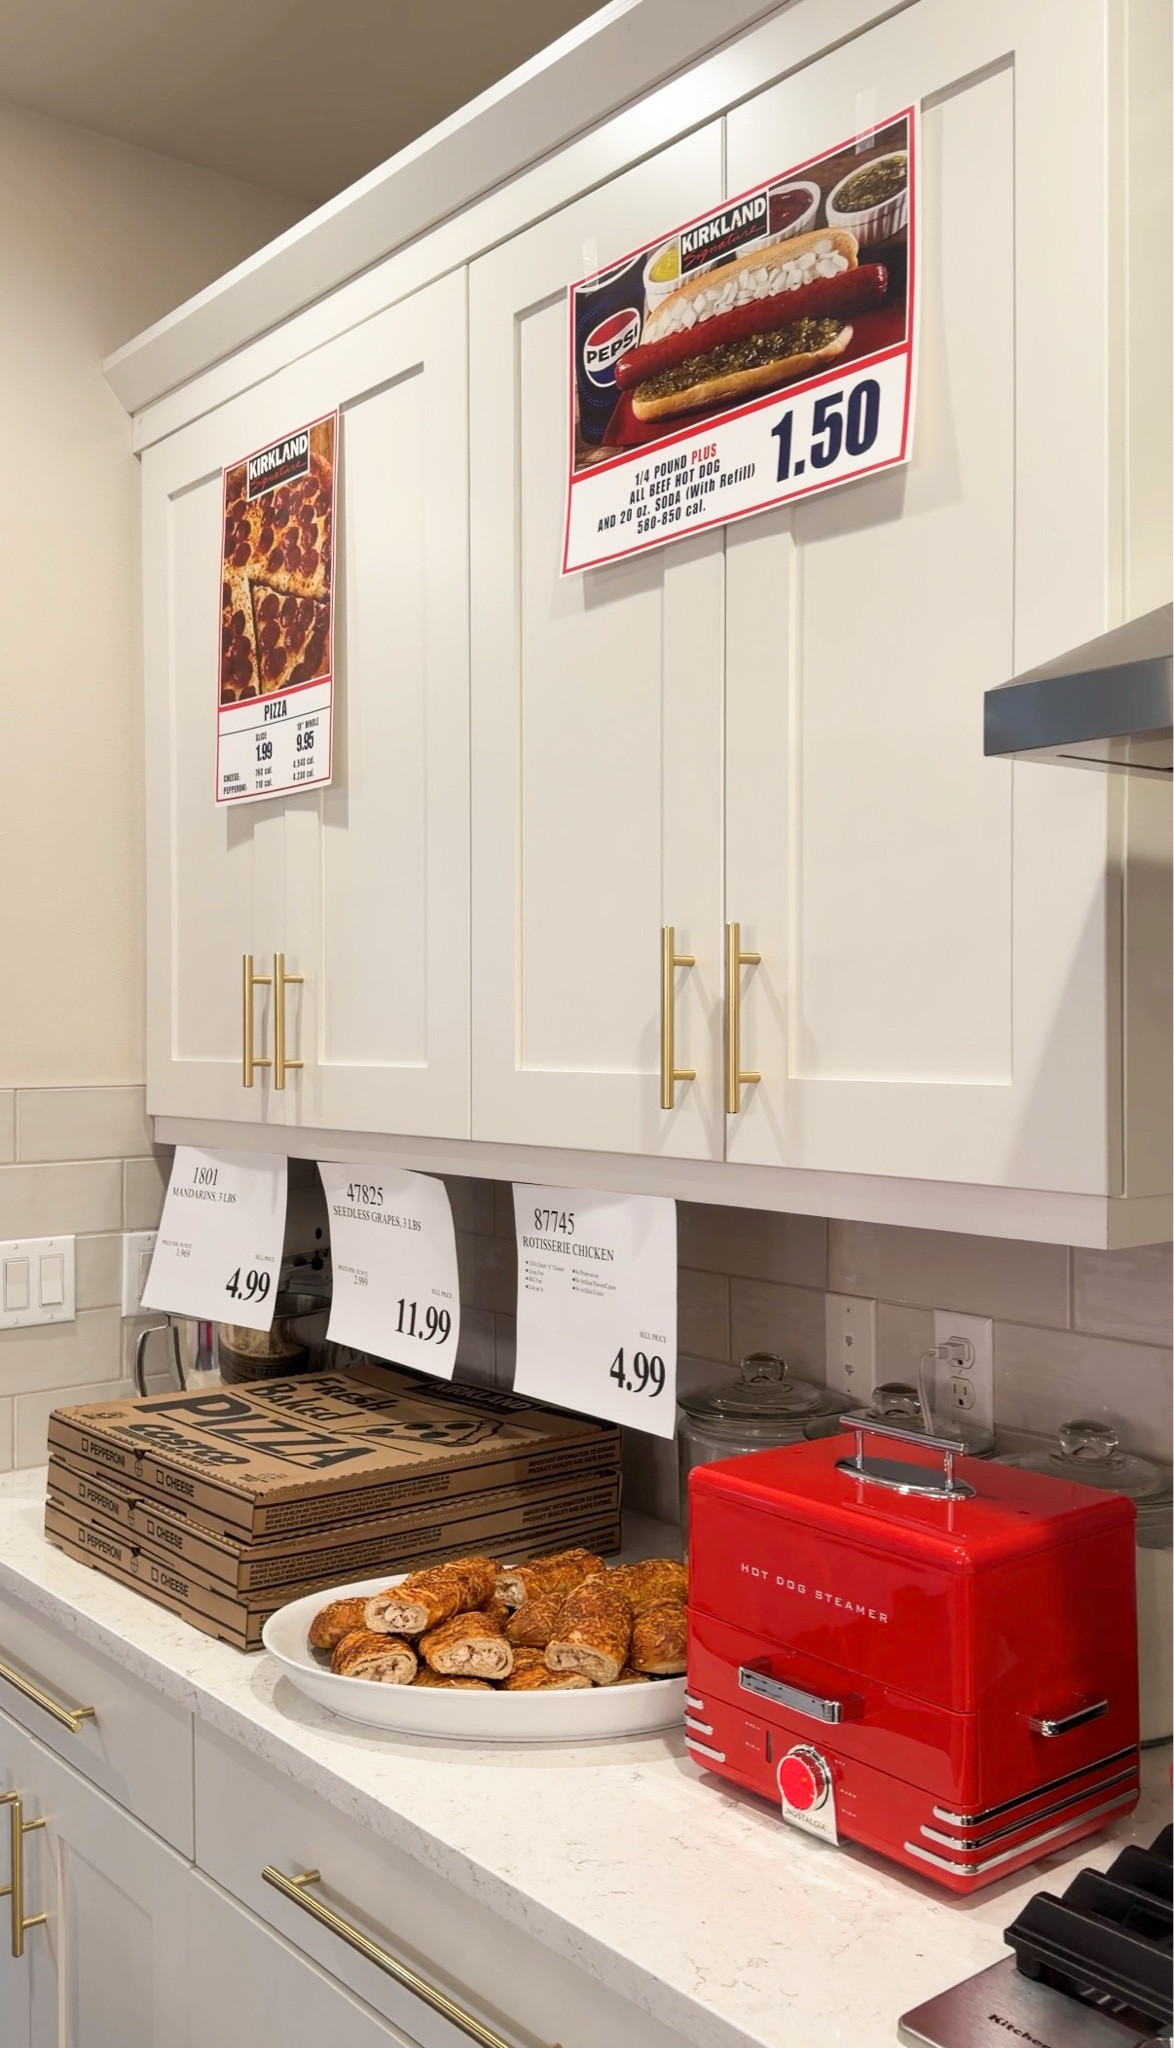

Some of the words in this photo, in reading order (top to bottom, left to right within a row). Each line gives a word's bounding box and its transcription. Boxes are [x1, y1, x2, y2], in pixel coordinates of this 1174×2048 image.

[681, 197, 767, 255] KIRKLAND
[683, 225, 765, 268] Signature
[586, 322, 639, 364] PEPSI
[770, 378, 881, 483] 1.50
[249, 434, 308, 480] KIRKLAND
[634, 468, 650, 486] 1/4
[654, 455, 687, 479] POUND
[691, 443, 717, 465] PLUS
[597, 514, 616, 533] AND
[620, 508, 633, 525] 20
[636, 504, 650, 519] oz.
[655, 490, 681, 512] SODA
[686, 477, 715, 500] (With
[719, 462, 756, 489] Refill)
[629, 488, 645, 505] ALL
[650, 477, 671, 497] BEEF
[675, 468, 696, 488] HOT
[700, 458, 720, 478] DOG
[637, 506, 682, 534] 580-850
[685, 498, 706, 517] cal.
[264, 700, 287, 721] PIZZA
[255, 732, 267, 742] SLICE
[255, 741, 273, 762] 1.99
[296, 730, 314, 752] 9.95
[172, 1187, 217, 1203] MANDARINS,
[217, 1192, 223, 1202] 3
[223, 1194, 237, 1204] LBS
[192, 1166, 219, 1186] 1801
[346, 1183, 384, 1206] 47825
[333, 1205, 370, 1221] SEEDLESS
[371, 1211, 402, 1228] GRAPES,
[402, 1218, 407, 1229] 3
[408, 1219, 422, 1231] LBS
[534, 1208, 575, 1236] 87745
[522, 1236, 571, 1254] ROTISSERIE
[572, 1243, 615, 1262] CHICKEN
[225, 1267, 271, 1303] 4.99
[395, 1298, 451, 1345] 11.99
[639, 1331, 651, 1340] SELL
[651, 1333, 667, 1344] PRICE
[609, 1347, 666, 1398] 4.99
[128, 1424, 251, 1465] COSTCO
[132, 1393, 377, 1468] PIZZA
[90, 1442, 126, 1468] PEPPERONI
[166, 1473, 195, 1498] CHEESE
[86, 1487, 120, 1515] PEPPERONI
[156, 1521, 183, 1550] CHEESE
[86, 1533, 122, 1561] PEPPERONI
[160, 1572, 189, 1598] CHEESE
[741, 1563, 768, 1580] HOT
[776, 1576, 806, 1595] DOG
[814, 1590, 889, 1624] STEAMER
